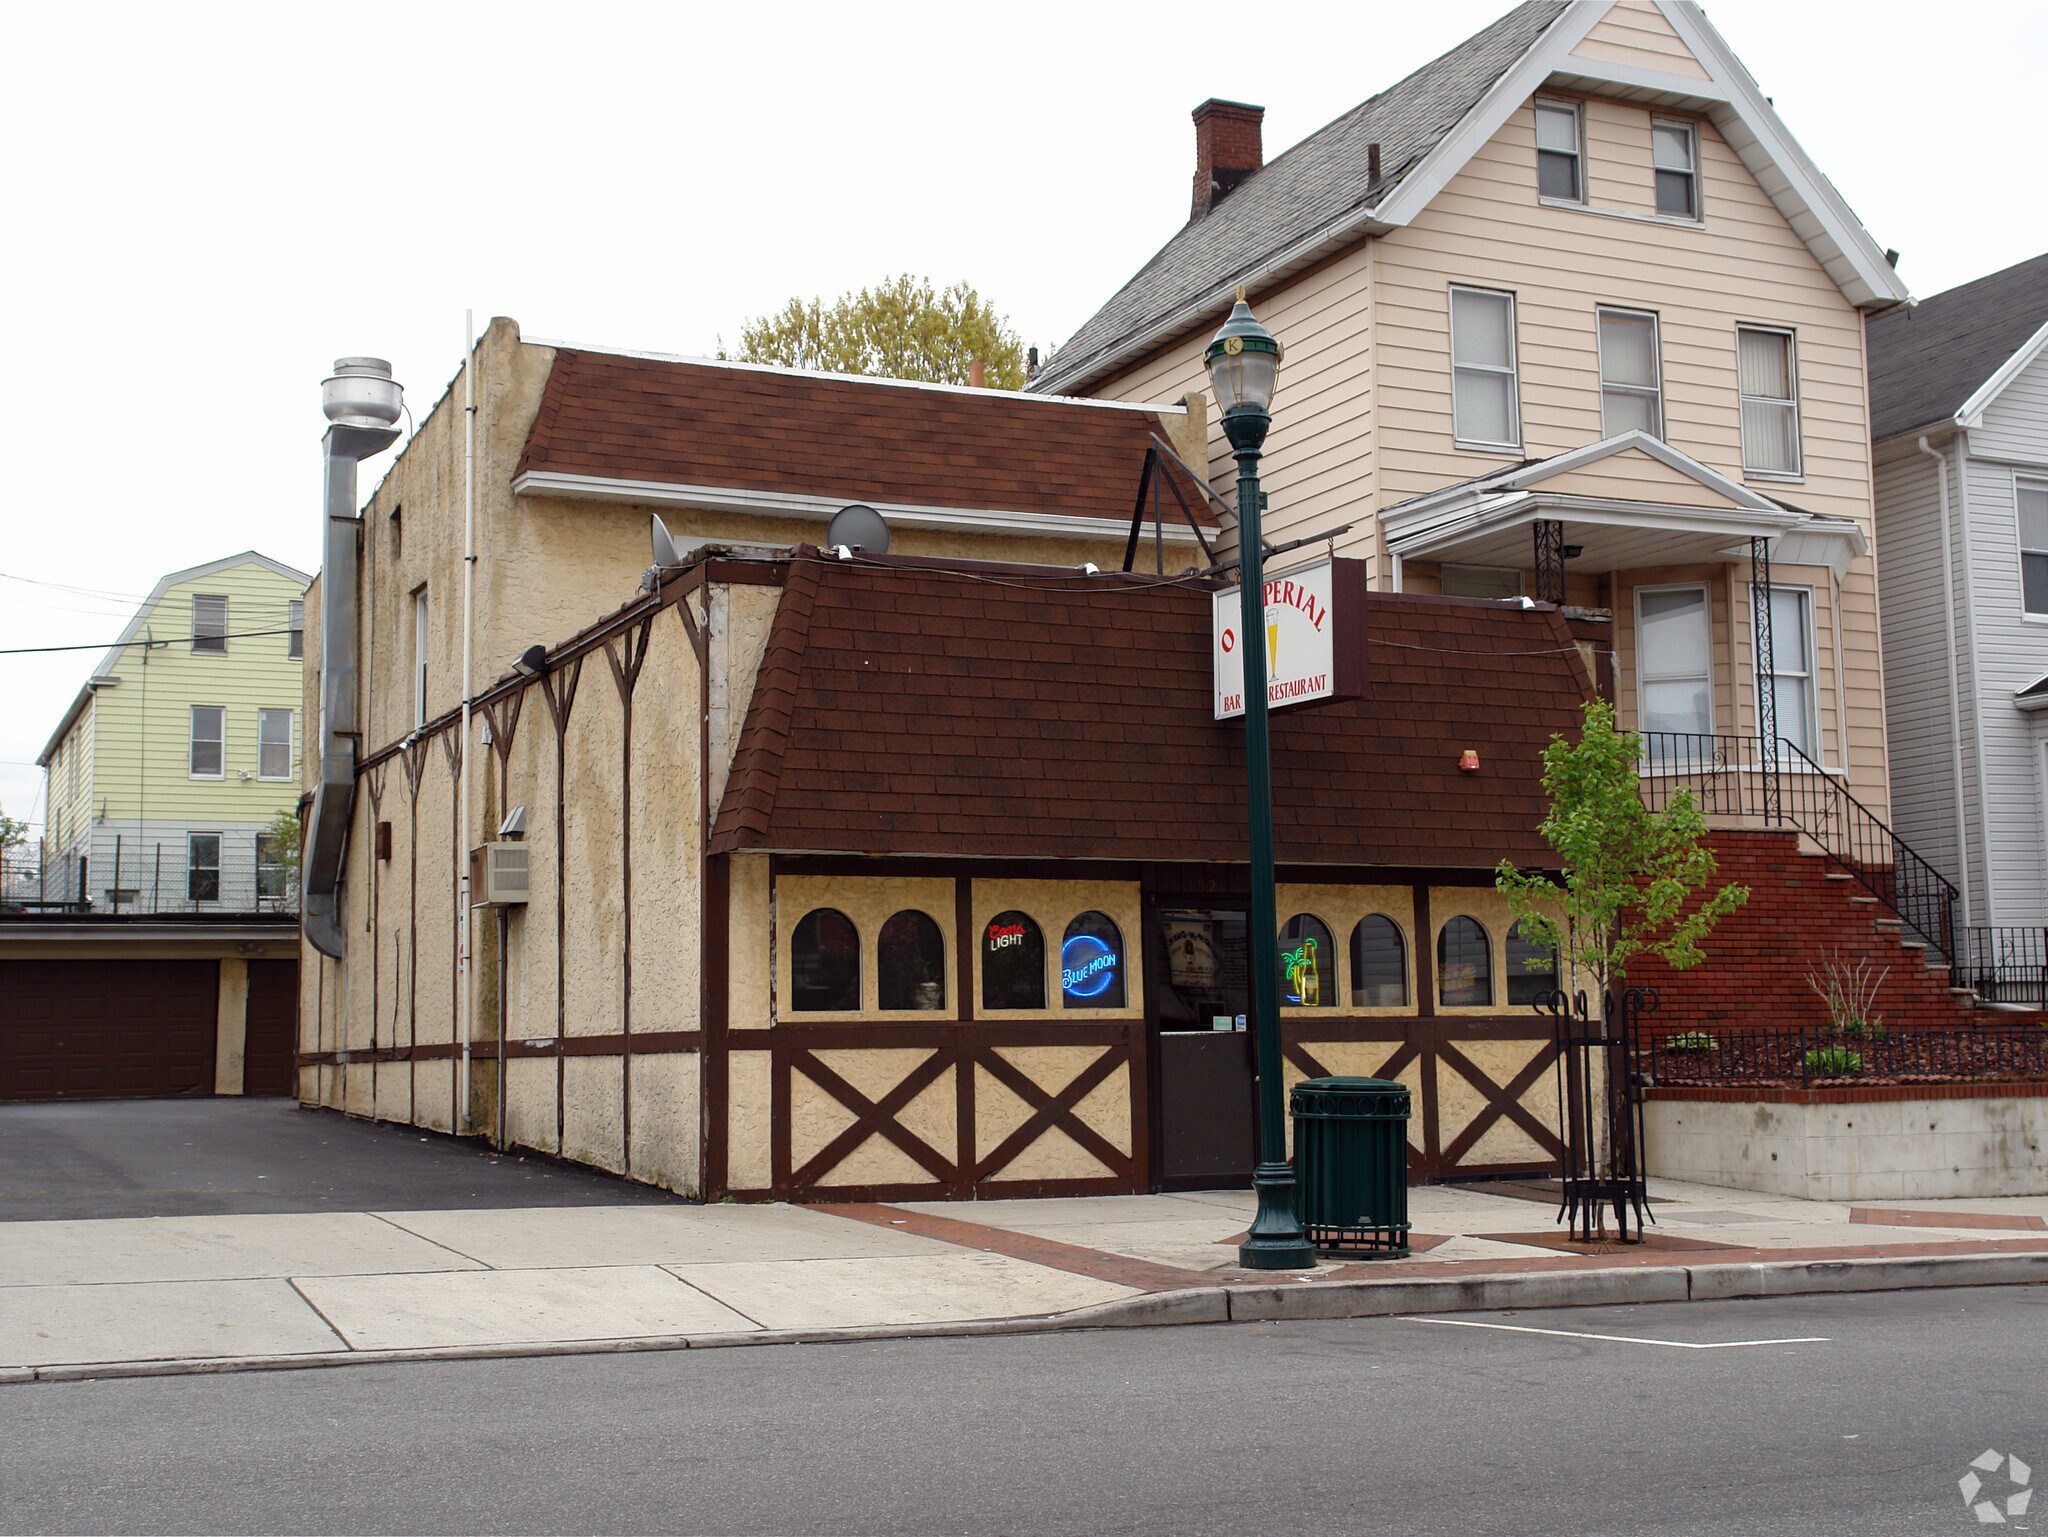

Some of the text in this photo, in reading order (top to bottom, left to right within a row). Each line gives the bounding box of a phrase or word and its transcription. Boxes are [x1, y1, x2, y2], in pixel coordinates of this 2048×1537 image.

[1228, 339, 1239, 352] K
[1262, 580, 1326, 633] PERIAL
[1224, 674, 1327, 712] BAR RESTAURANT
[991, 934, 1023, 951] LIGHT
[1062, 953, 1116, 989] BLUE MOON
